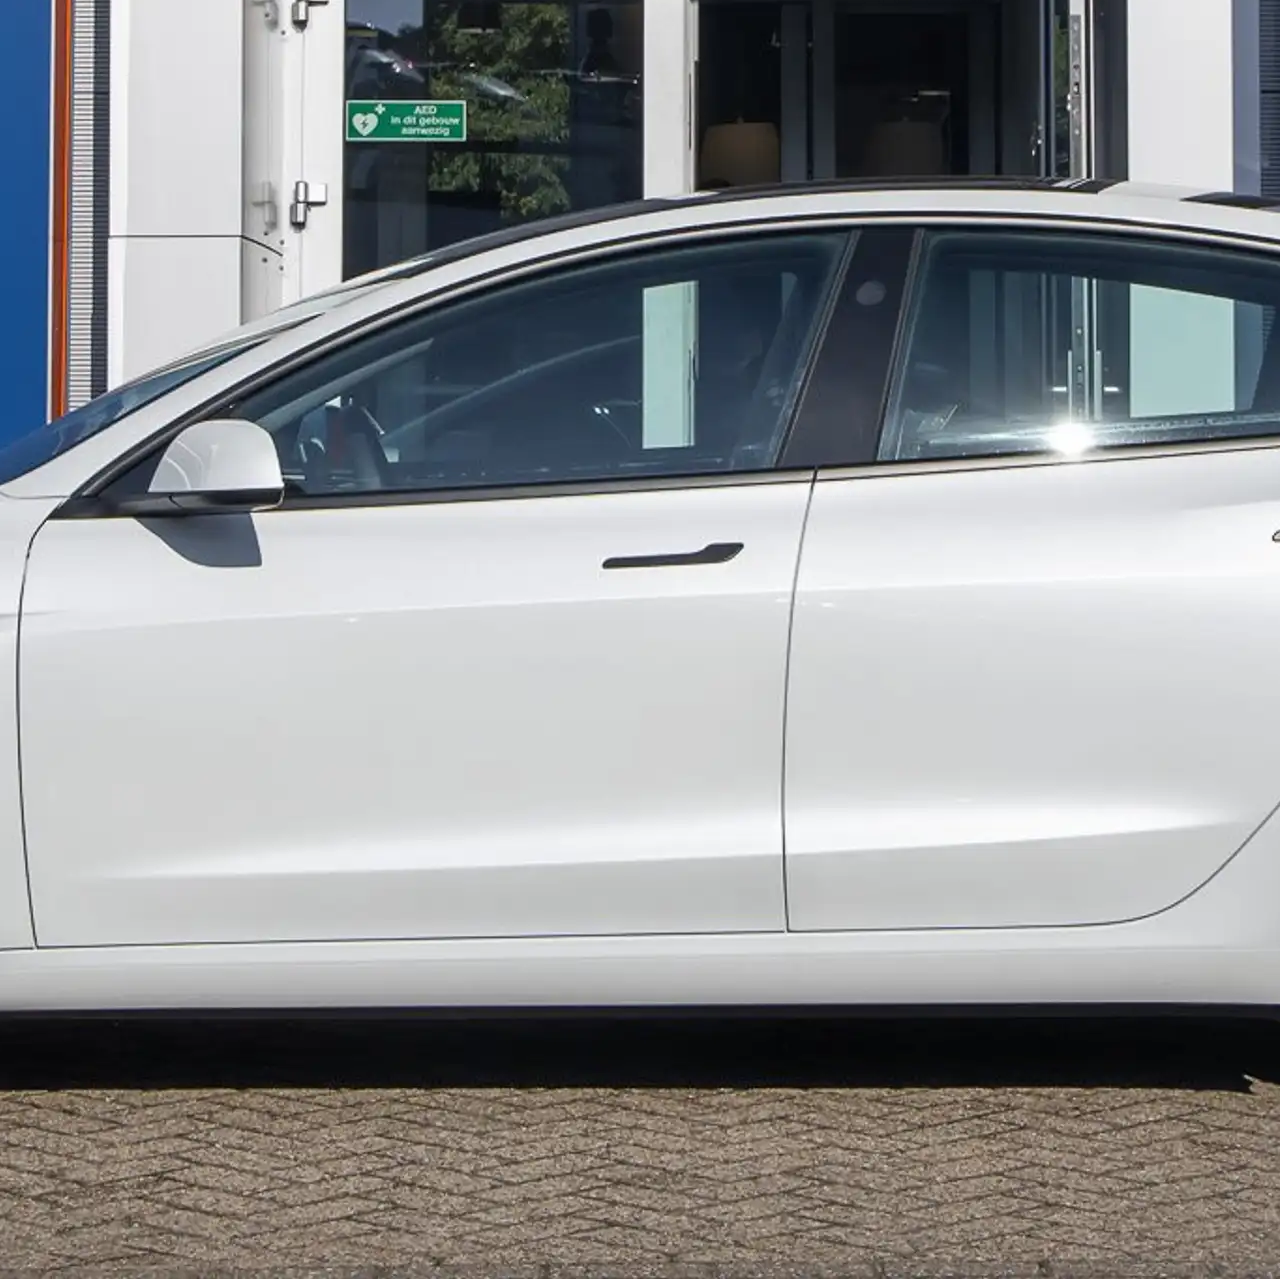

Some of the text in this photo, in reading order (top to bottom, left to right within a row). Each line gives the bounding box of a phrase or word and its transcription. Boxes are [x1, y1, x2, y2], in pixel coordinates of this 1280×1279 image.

[414, 105, 437, 114] AED
[403, 115, 417, 125] dit
[419, 115, 460, 126] gebouw
